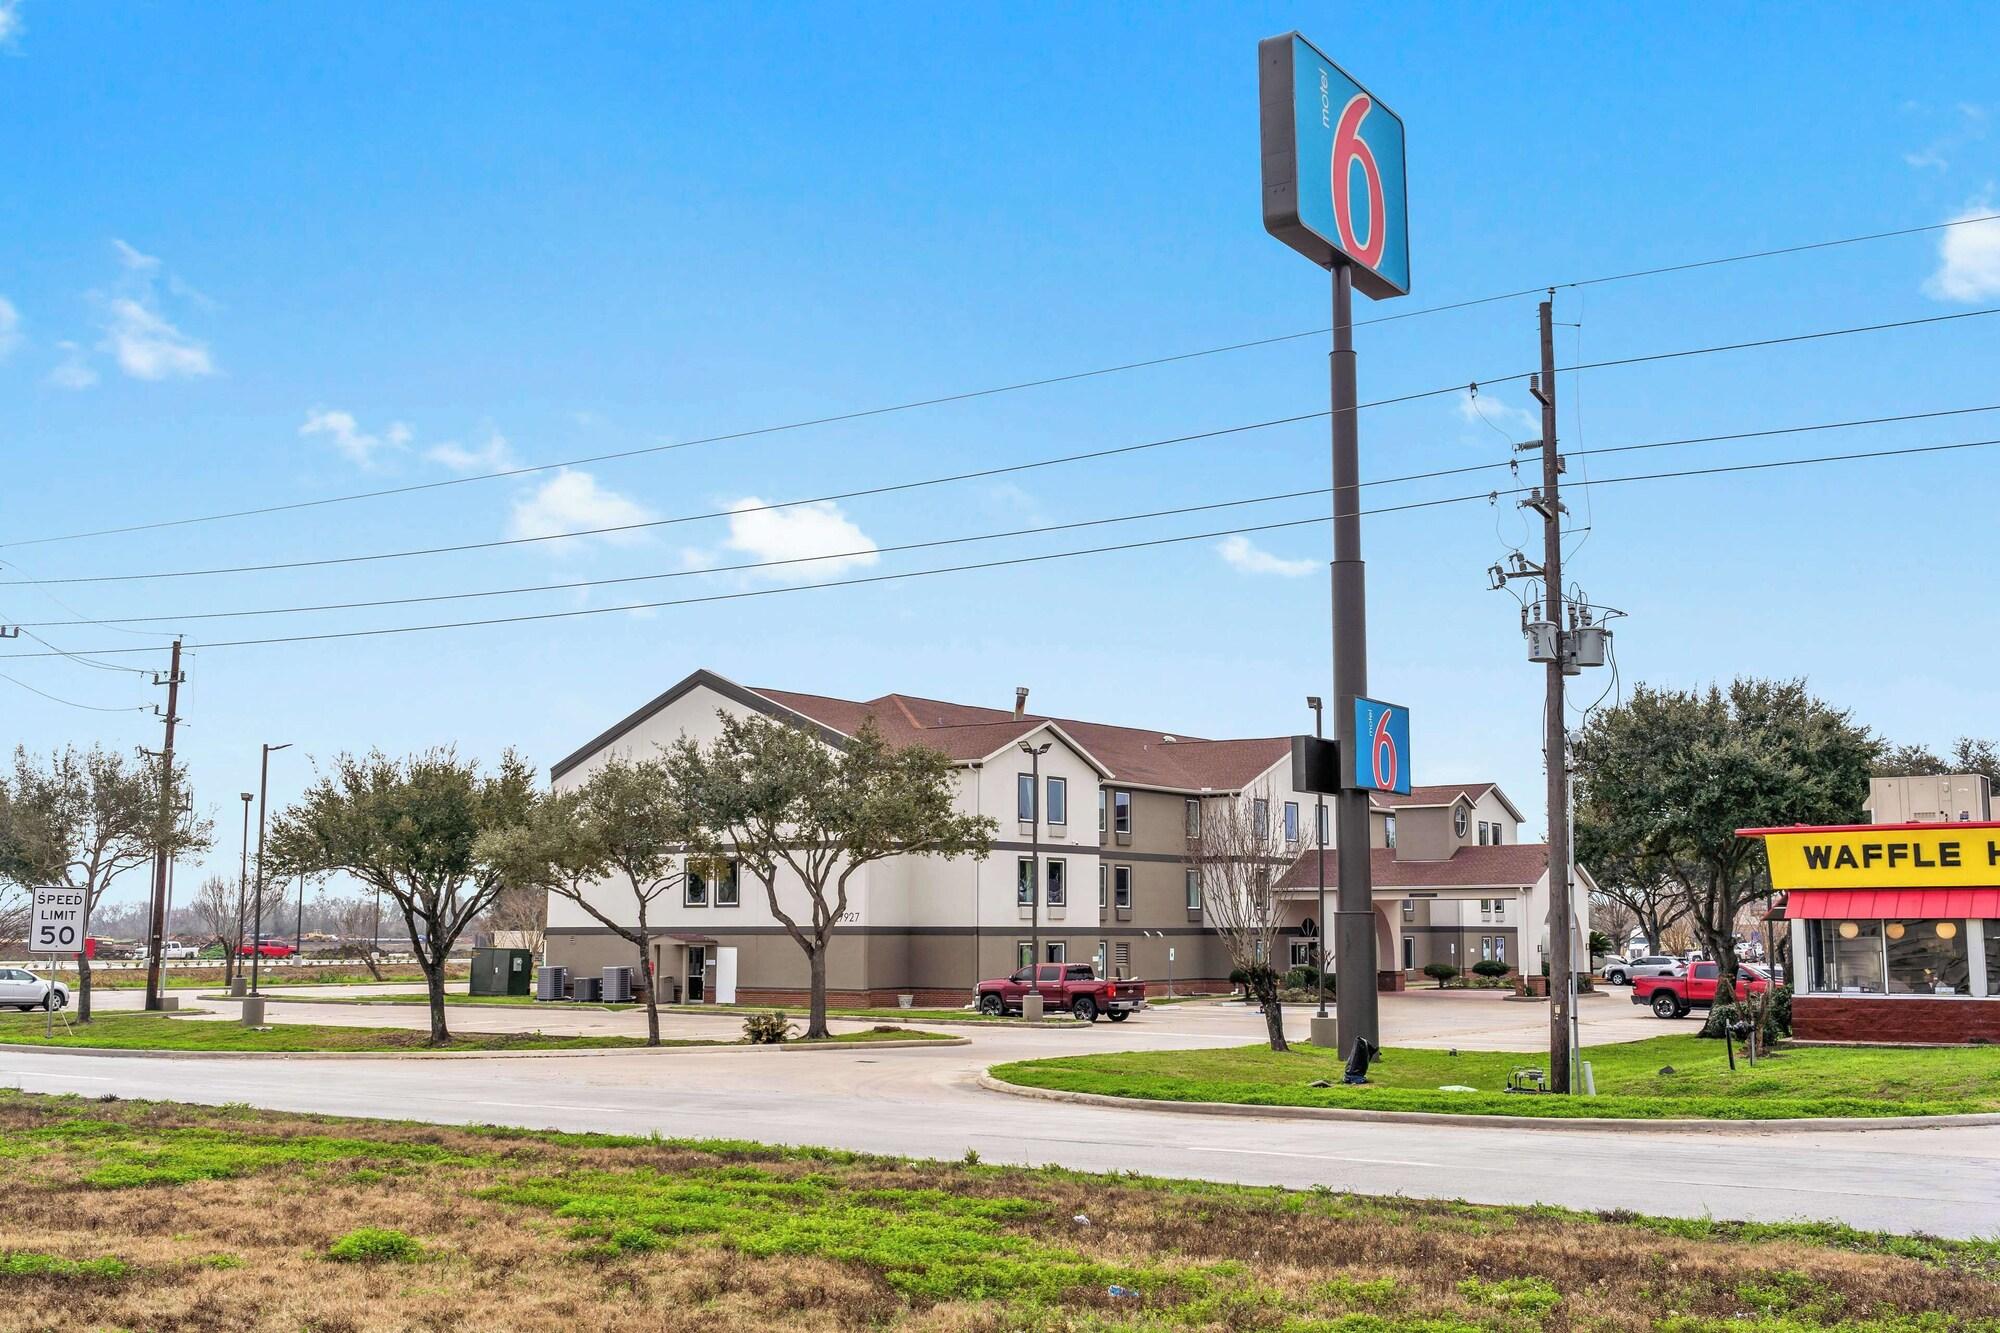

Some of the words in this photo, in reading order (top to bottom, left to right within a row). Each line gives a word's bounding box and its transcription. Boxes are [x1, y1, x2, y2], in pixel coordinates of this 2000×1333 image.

[1319, 67, 1330, 128] motel
[1331, 92, 1385, 270] 6
[1372, 708, 1397, 791] 6
[1803, 842, 1961, 870] WAFFLE
[38, 894, 83, 905] SPEED
[41, 910, 76, 920] LIMIT
[40, 926, 75, 944] 50
